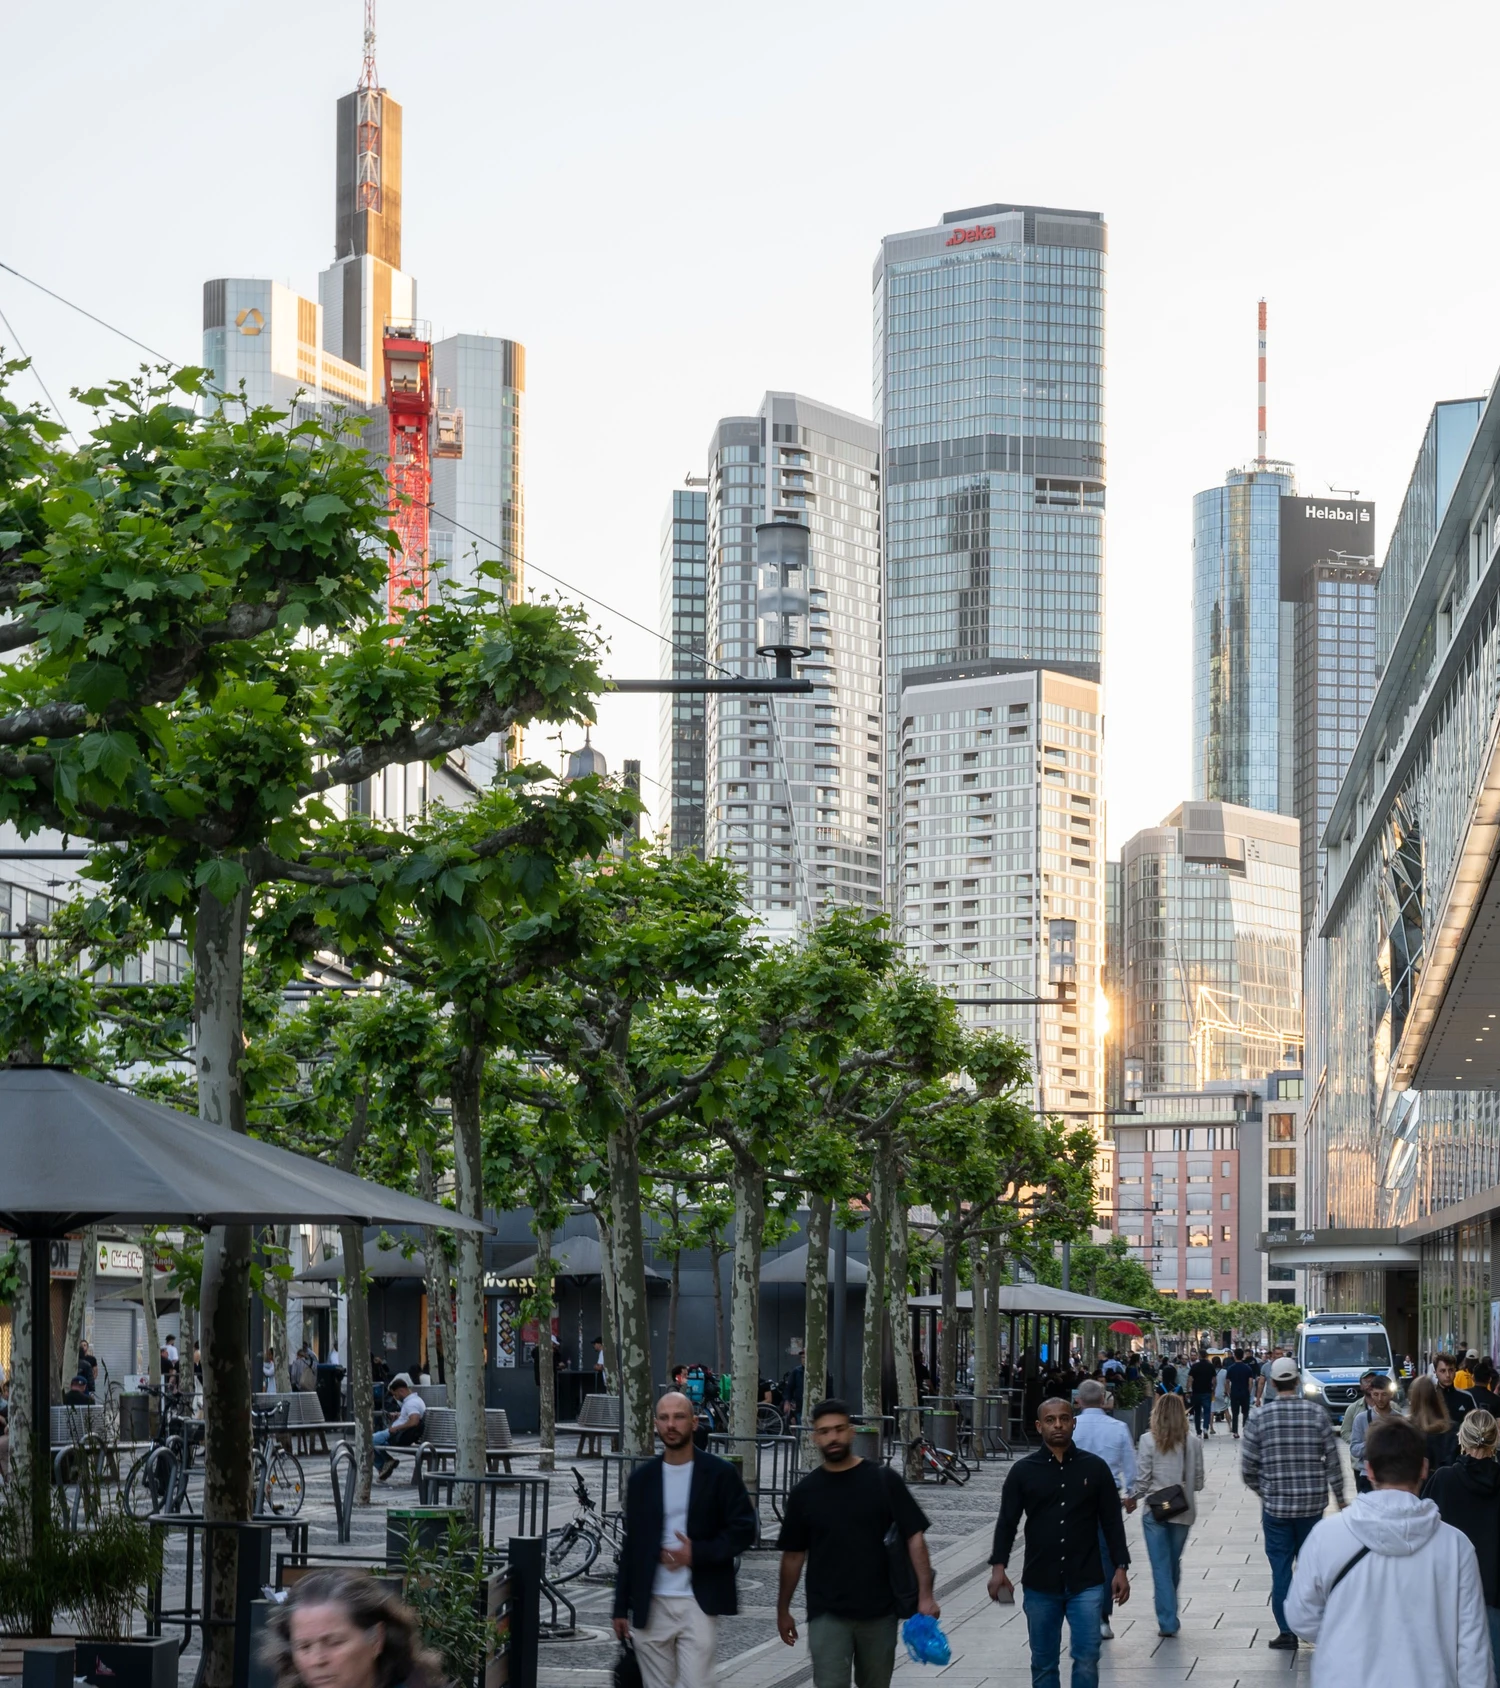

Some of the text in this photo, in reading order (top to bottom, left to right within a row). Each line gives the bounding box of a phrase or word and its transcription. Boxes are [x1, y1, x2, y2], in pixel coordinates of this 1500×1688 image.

[953, 224, 996, 245] Deka
[1305, 505, 1354, 522] Helaba
[1331, 1372, 1360, 1380] POLIZ
